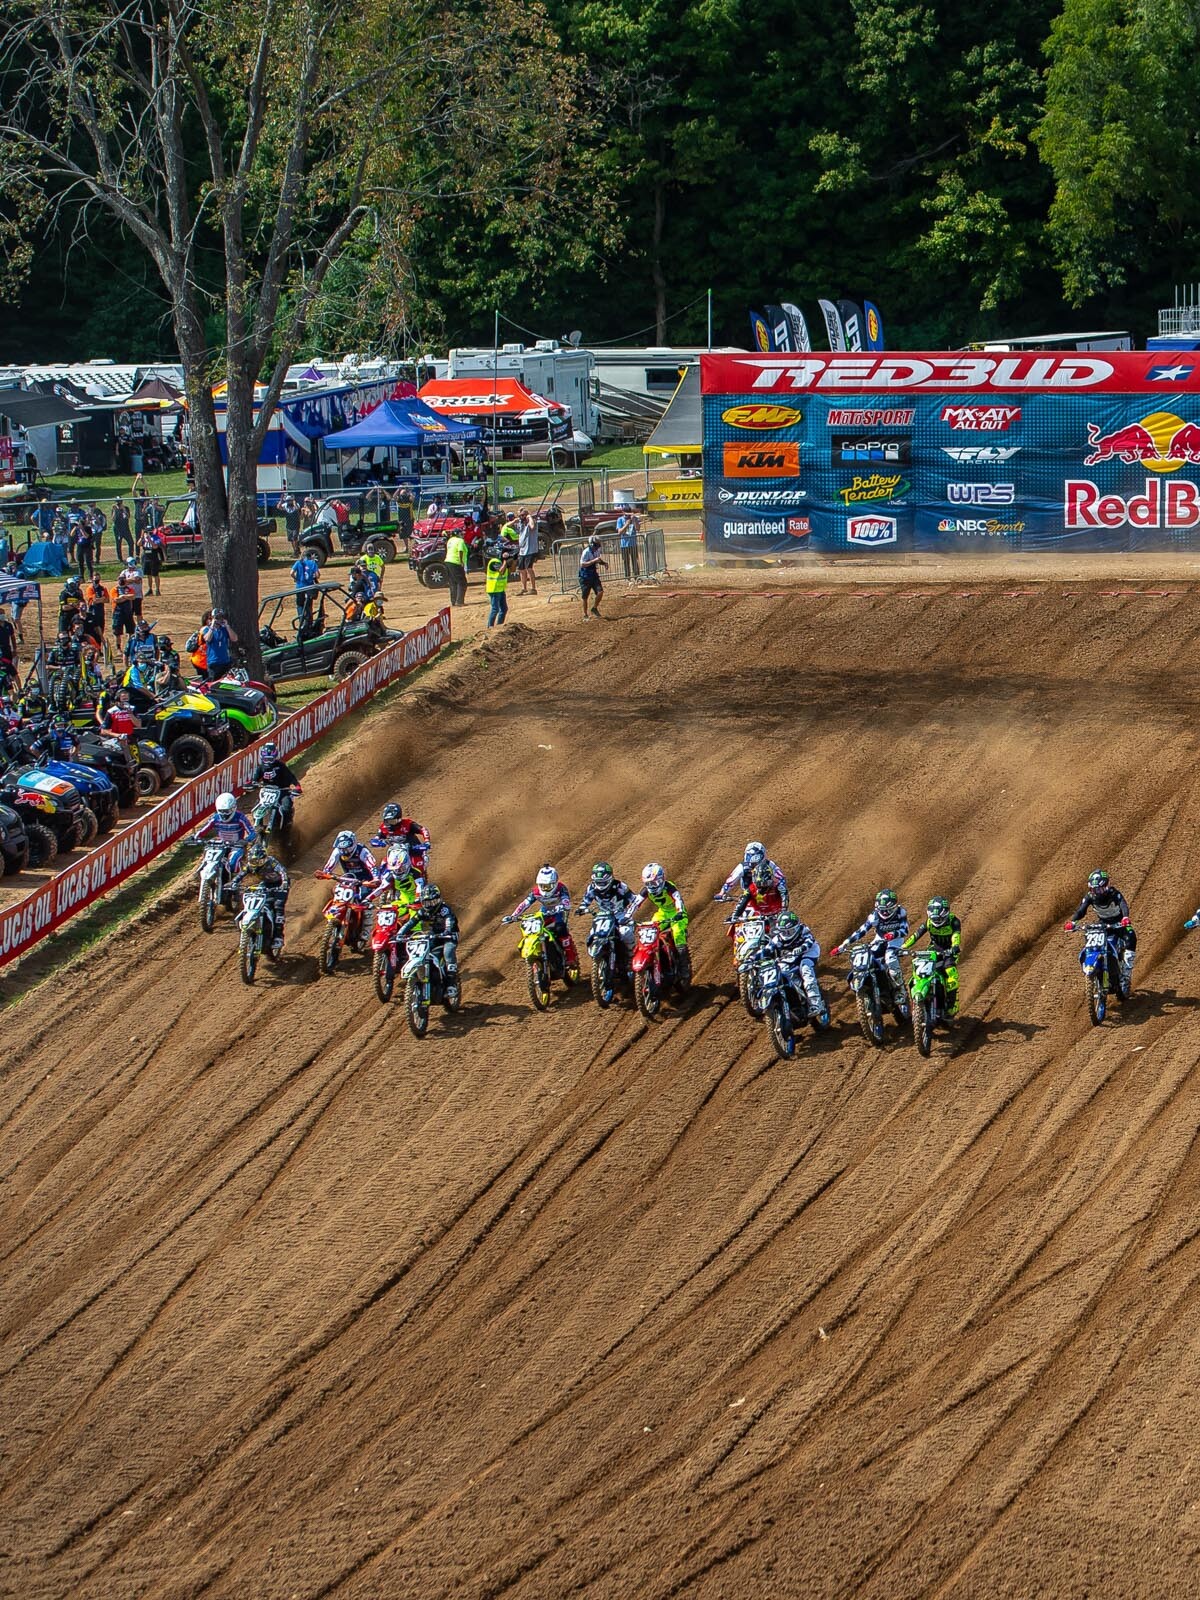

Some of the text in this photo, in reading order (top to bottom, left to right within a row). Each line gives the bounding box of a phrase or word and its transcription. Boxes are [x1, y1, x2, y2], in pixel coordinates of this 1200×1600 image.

[732, 359, 1114, 388] REDBUD
[440, 394, 514, 407] RISK
[723, 408, 801, 423] FMF
[941, 408, 974, 421] MX
[980, 407, 1021, 421] ATV
[951, 421, 1006, 430] ALL OUT
[842, 441, 899, 450] GoPro
[940, 447, 1022, 460] FLY
[737, 452, 785, 468] KTM
[852, 475, 901, 491] Battery
[734, 490, 806, 500] DUNLOP
[840, 486, 895, 506] Tender
[947, 484, 1014, 504] WPS
[1064, 478, 1160, 529] Red
[723, 518, 809, 538] guaranteed Rate
[854, 523, 890, 539] 100%
[957, 520, 1025, 533] NBC Sports
[299, 712, 312, 743] OIL
[195, 765, 234, 815] LUCAS OIL
[157, 792, 192, 844] LUCAS OIL
[110, 821, 154, 878] LUCAS OIL
[56, 853, 107, 917] LUCAS OIL
[335, 888, 353, 901] 30
[35, 891, 52, 932] OIL
[595, 919, 611, 932] 14
[1086, 933, 1104, 947] 239
[408, 943, 427, 959] 24
[853, 954, 869, 967] 41
[916, 960, 933, 975] 74
[762, 970, 777, 984] 12
